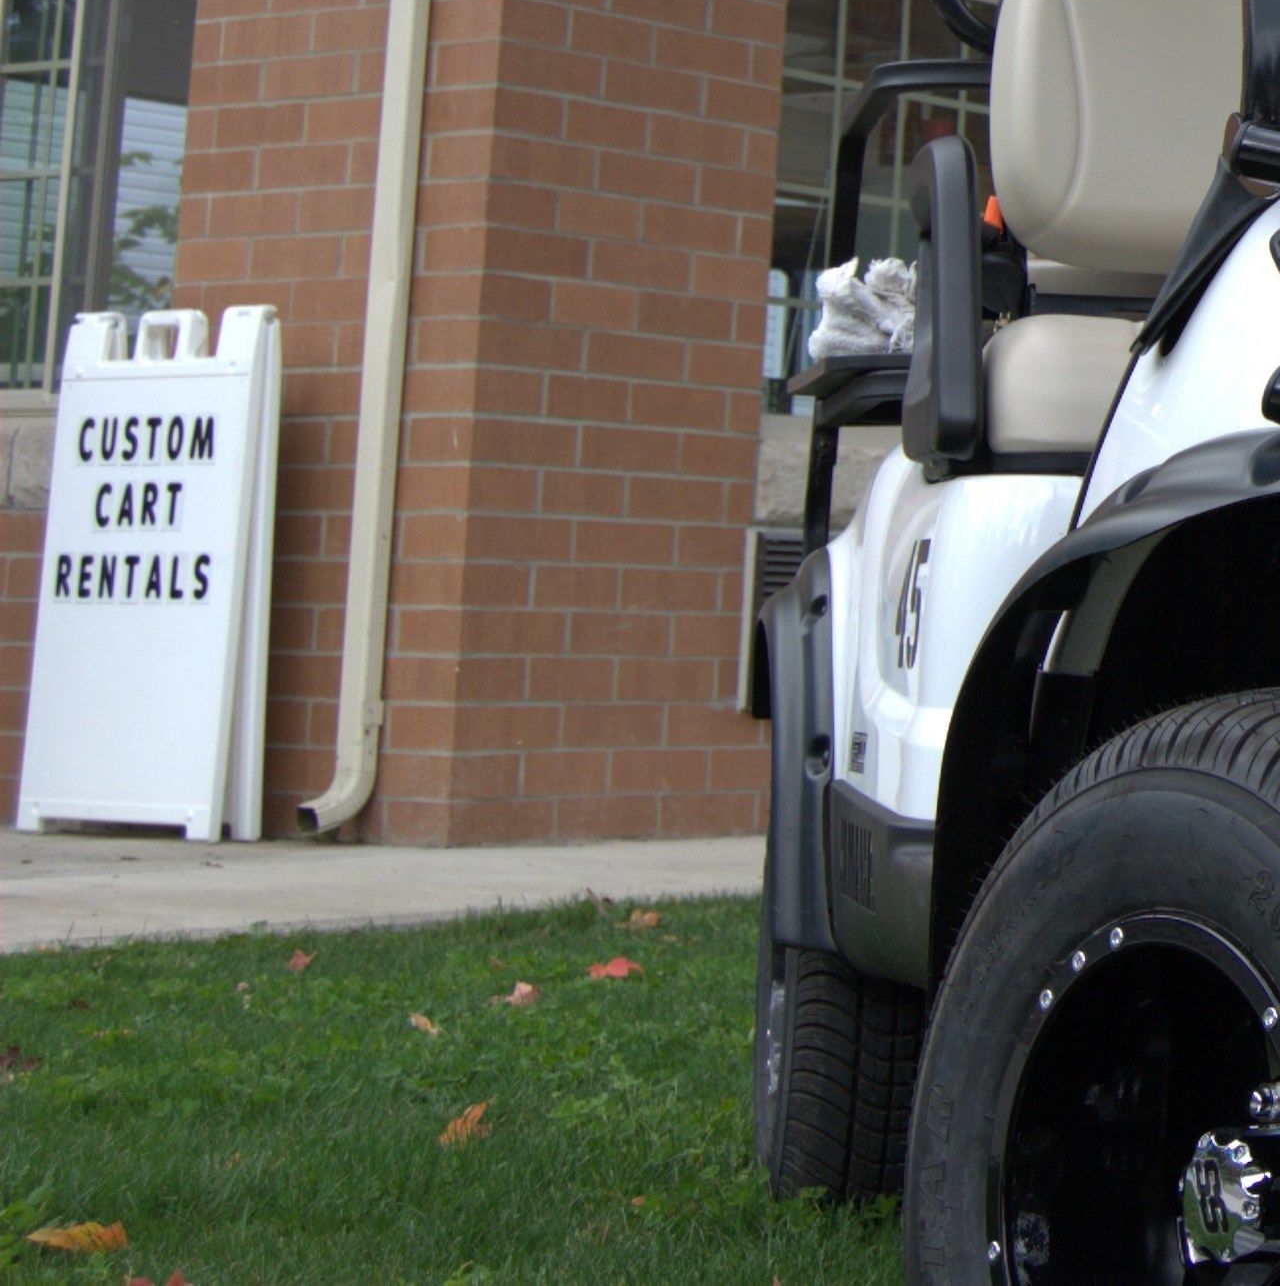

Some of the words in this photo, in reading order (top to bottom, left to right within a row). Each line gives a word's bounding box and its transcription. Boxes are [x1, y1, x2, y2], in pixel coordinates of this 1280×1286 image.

[77, 415, 216, 461] CUSTOM
[94, 482, 183, 528] CART
[55, 554, 212, 600] RENTALS
